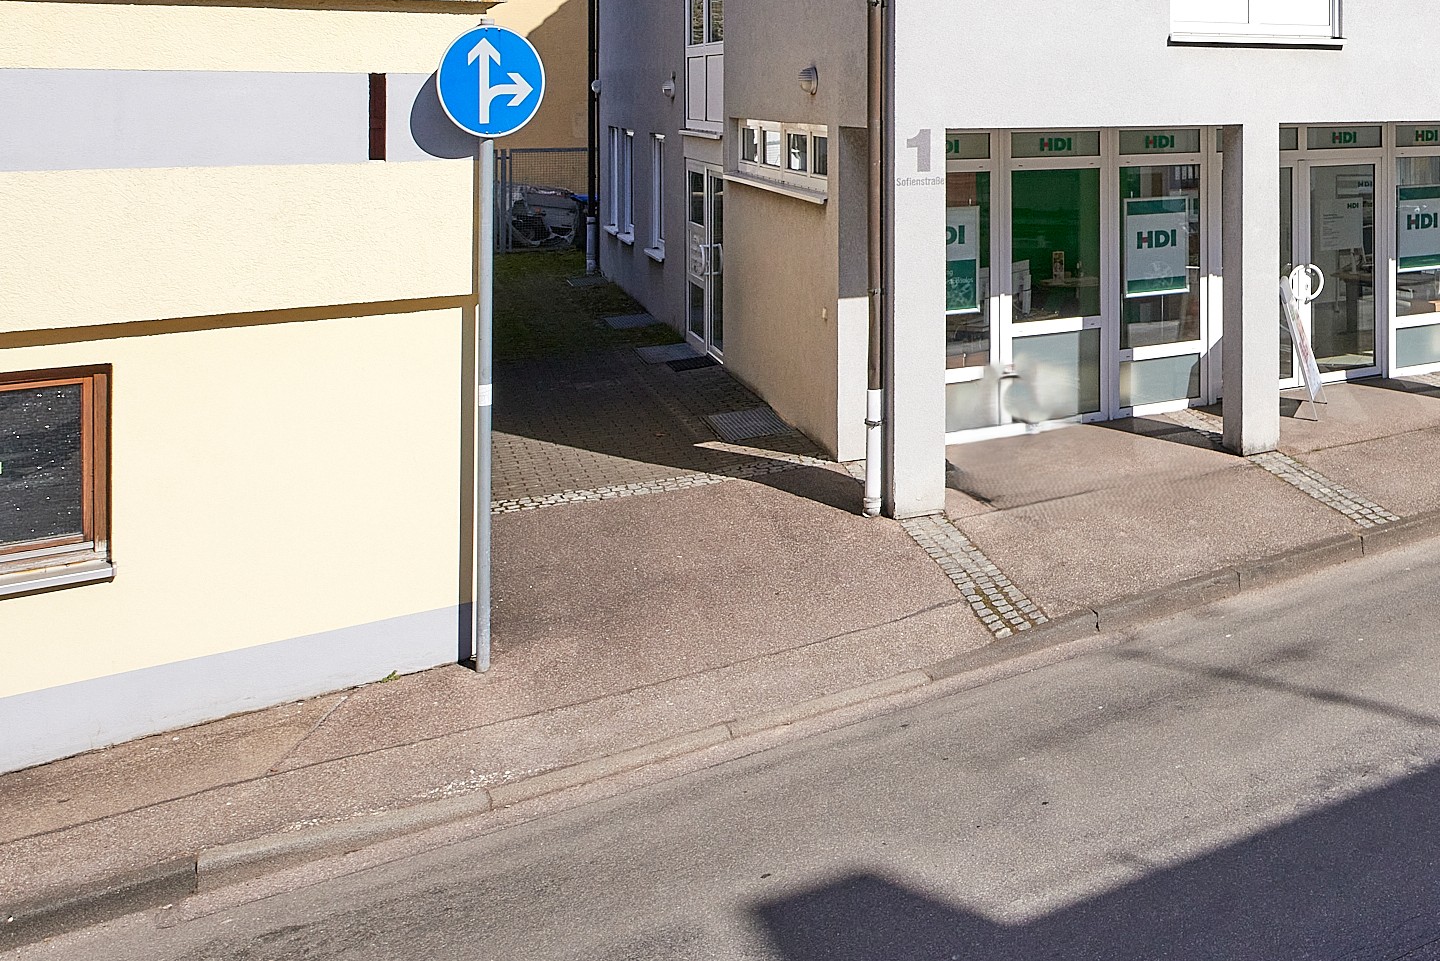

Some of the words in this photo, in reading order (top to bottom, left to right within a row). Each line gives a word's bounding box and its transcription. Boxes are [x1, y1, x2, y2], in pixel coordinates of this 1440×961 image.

[1145, 135, 1175, 149] HDI
[1331, 131, 1357, 144] HDI
[1415, 129, 1438, 142] HDI
[906, 128, 931, 172] 1
[1039, 137, 1072, 152] HDI
[896, 176, 945, 186] Sofienstraße
[1407, 213, 1438, 230] HDI
[946, 225, 965, 246] DI
[1136, 229, 1177, 249] HDI
